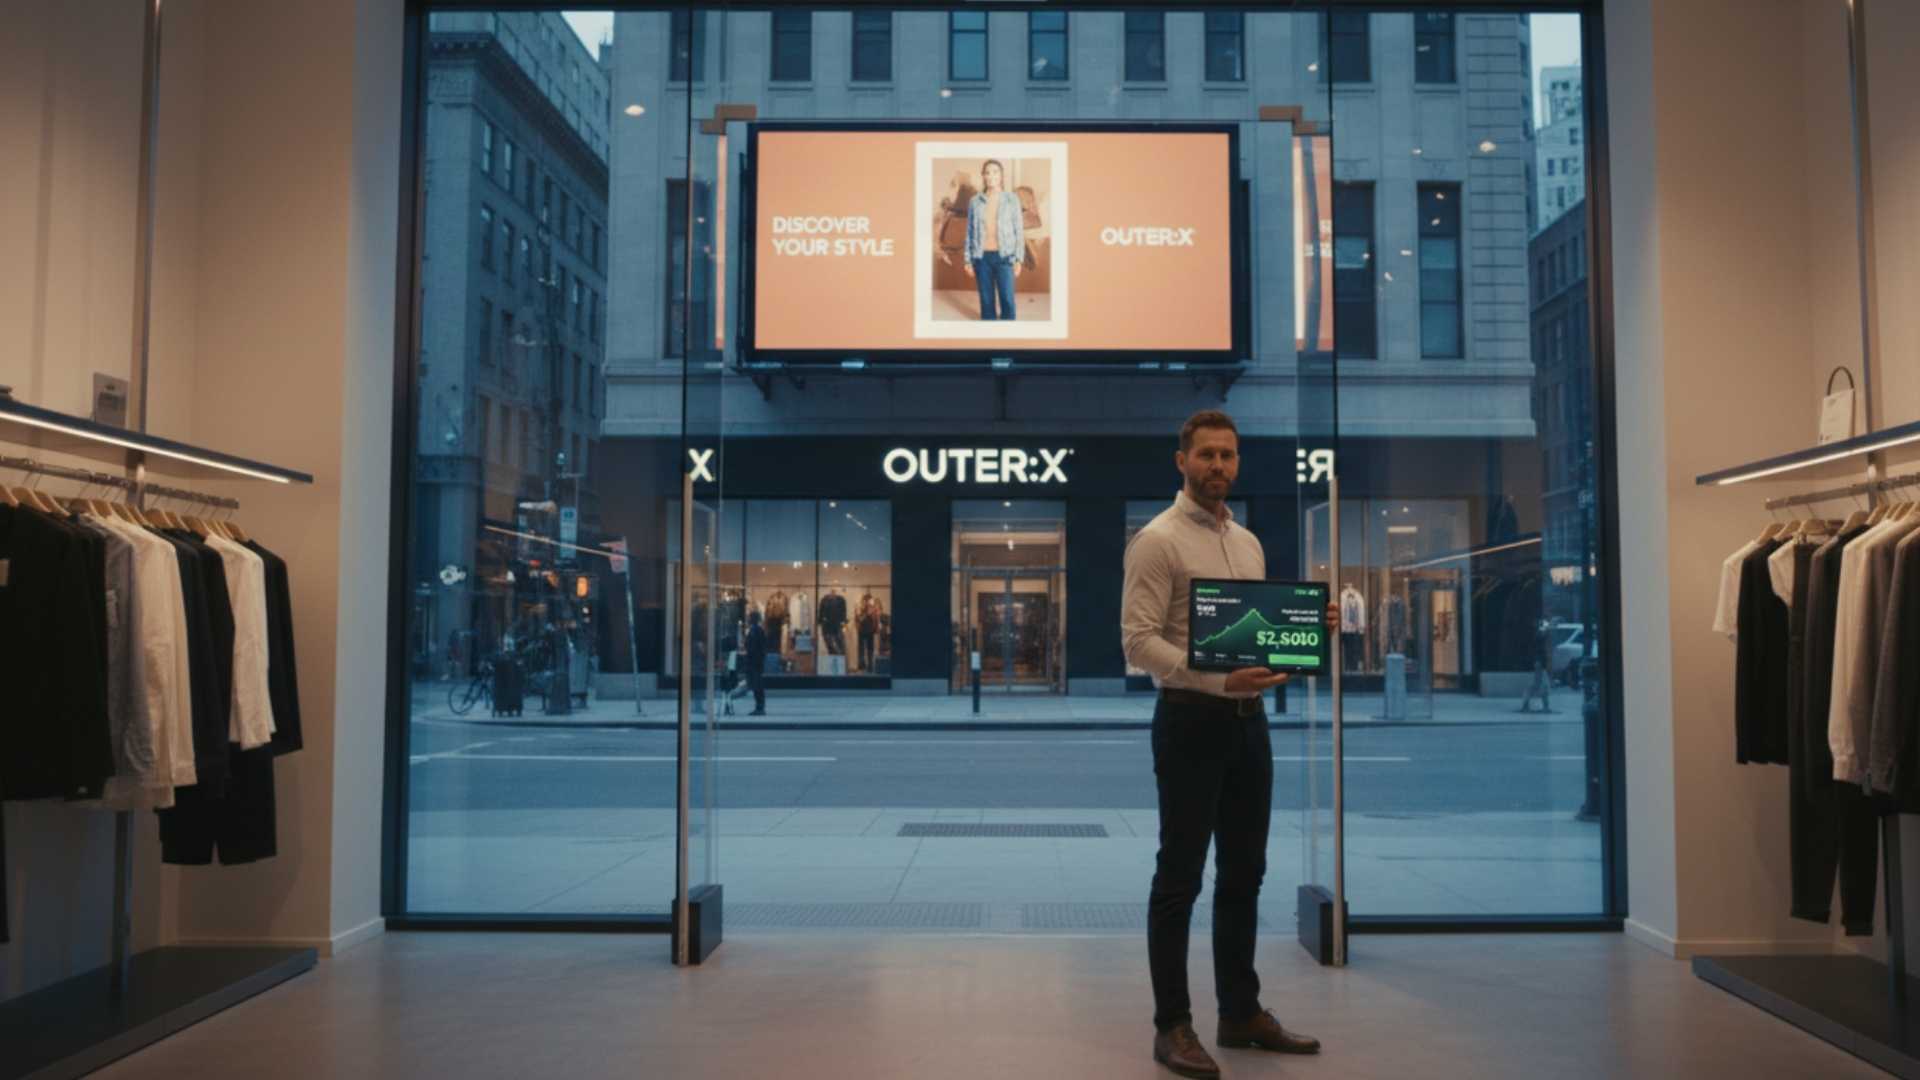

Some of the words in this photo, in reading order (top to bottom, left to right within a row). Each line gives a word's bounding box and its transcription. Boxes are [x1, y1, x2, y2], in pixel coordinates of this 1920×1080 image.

[772, 215, 870, 234] DISCOVER
[1100, 226, 1195, 247] OUTER:X
[772, 238, 830, 257] YOUR
[833, 238, 895, 257] STYLE
[882, 447, 1070, 484] OUTER:X
